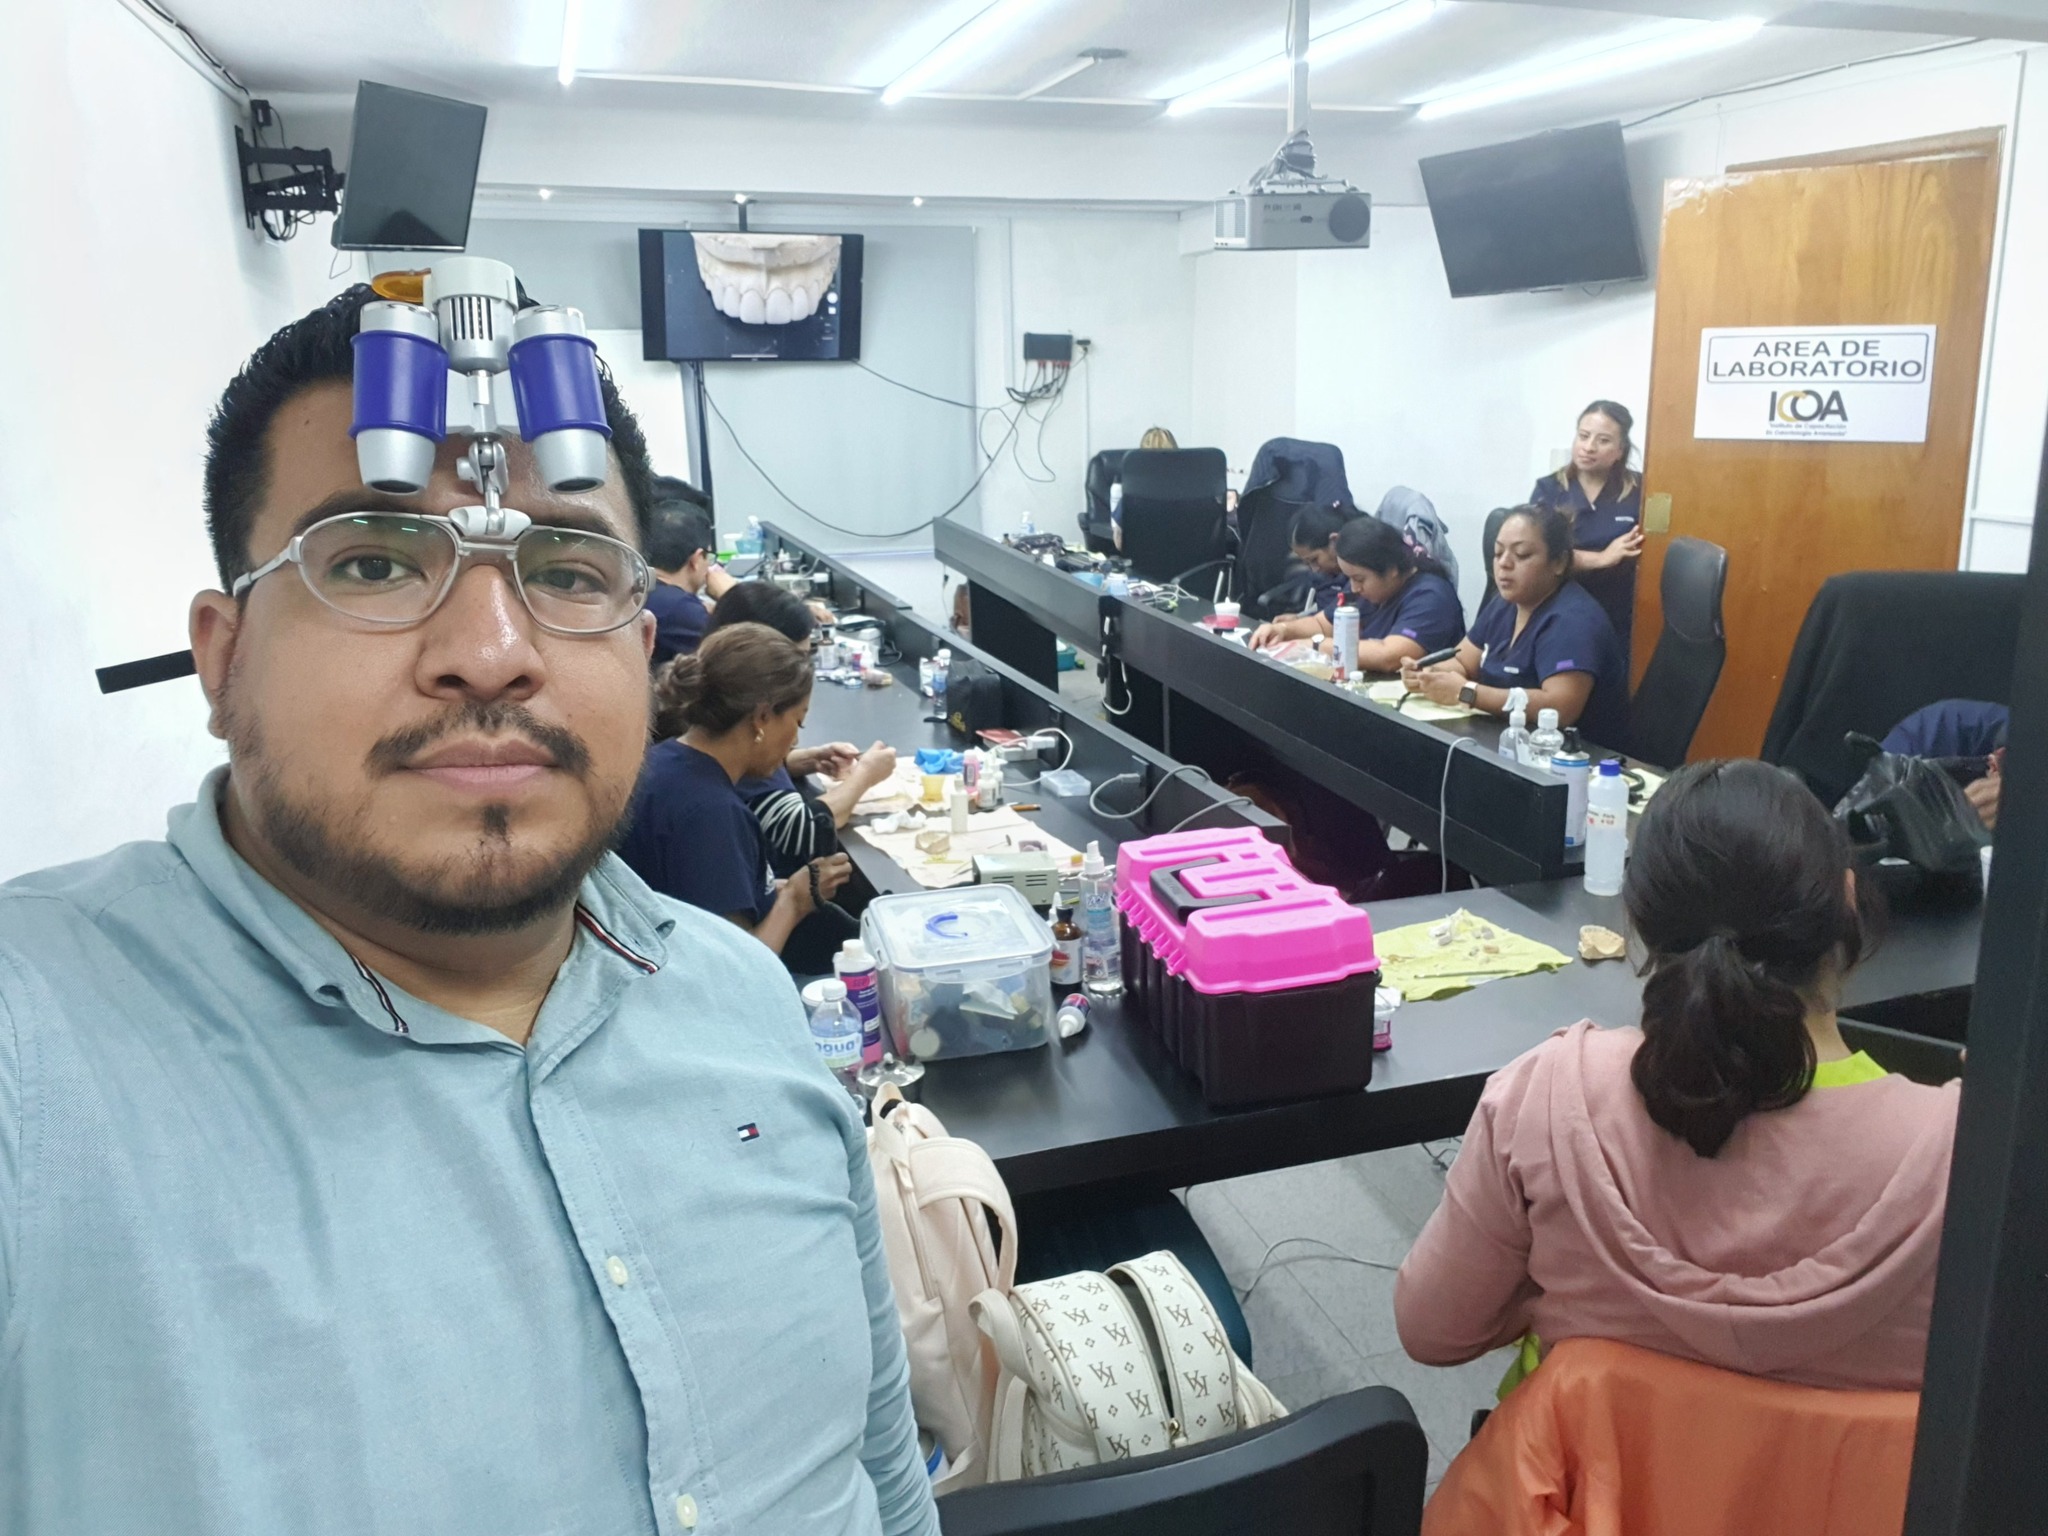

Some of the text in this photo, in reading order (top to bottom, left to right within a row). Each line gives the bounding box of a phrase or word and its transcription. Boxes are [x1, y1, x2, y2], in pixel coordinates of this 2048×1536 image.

[1753, 340, 1880, 357] AREA DE
[1713, 360, 1922, 377] LABORATORIO
[1769, 390, 1848, 422] ICOA
